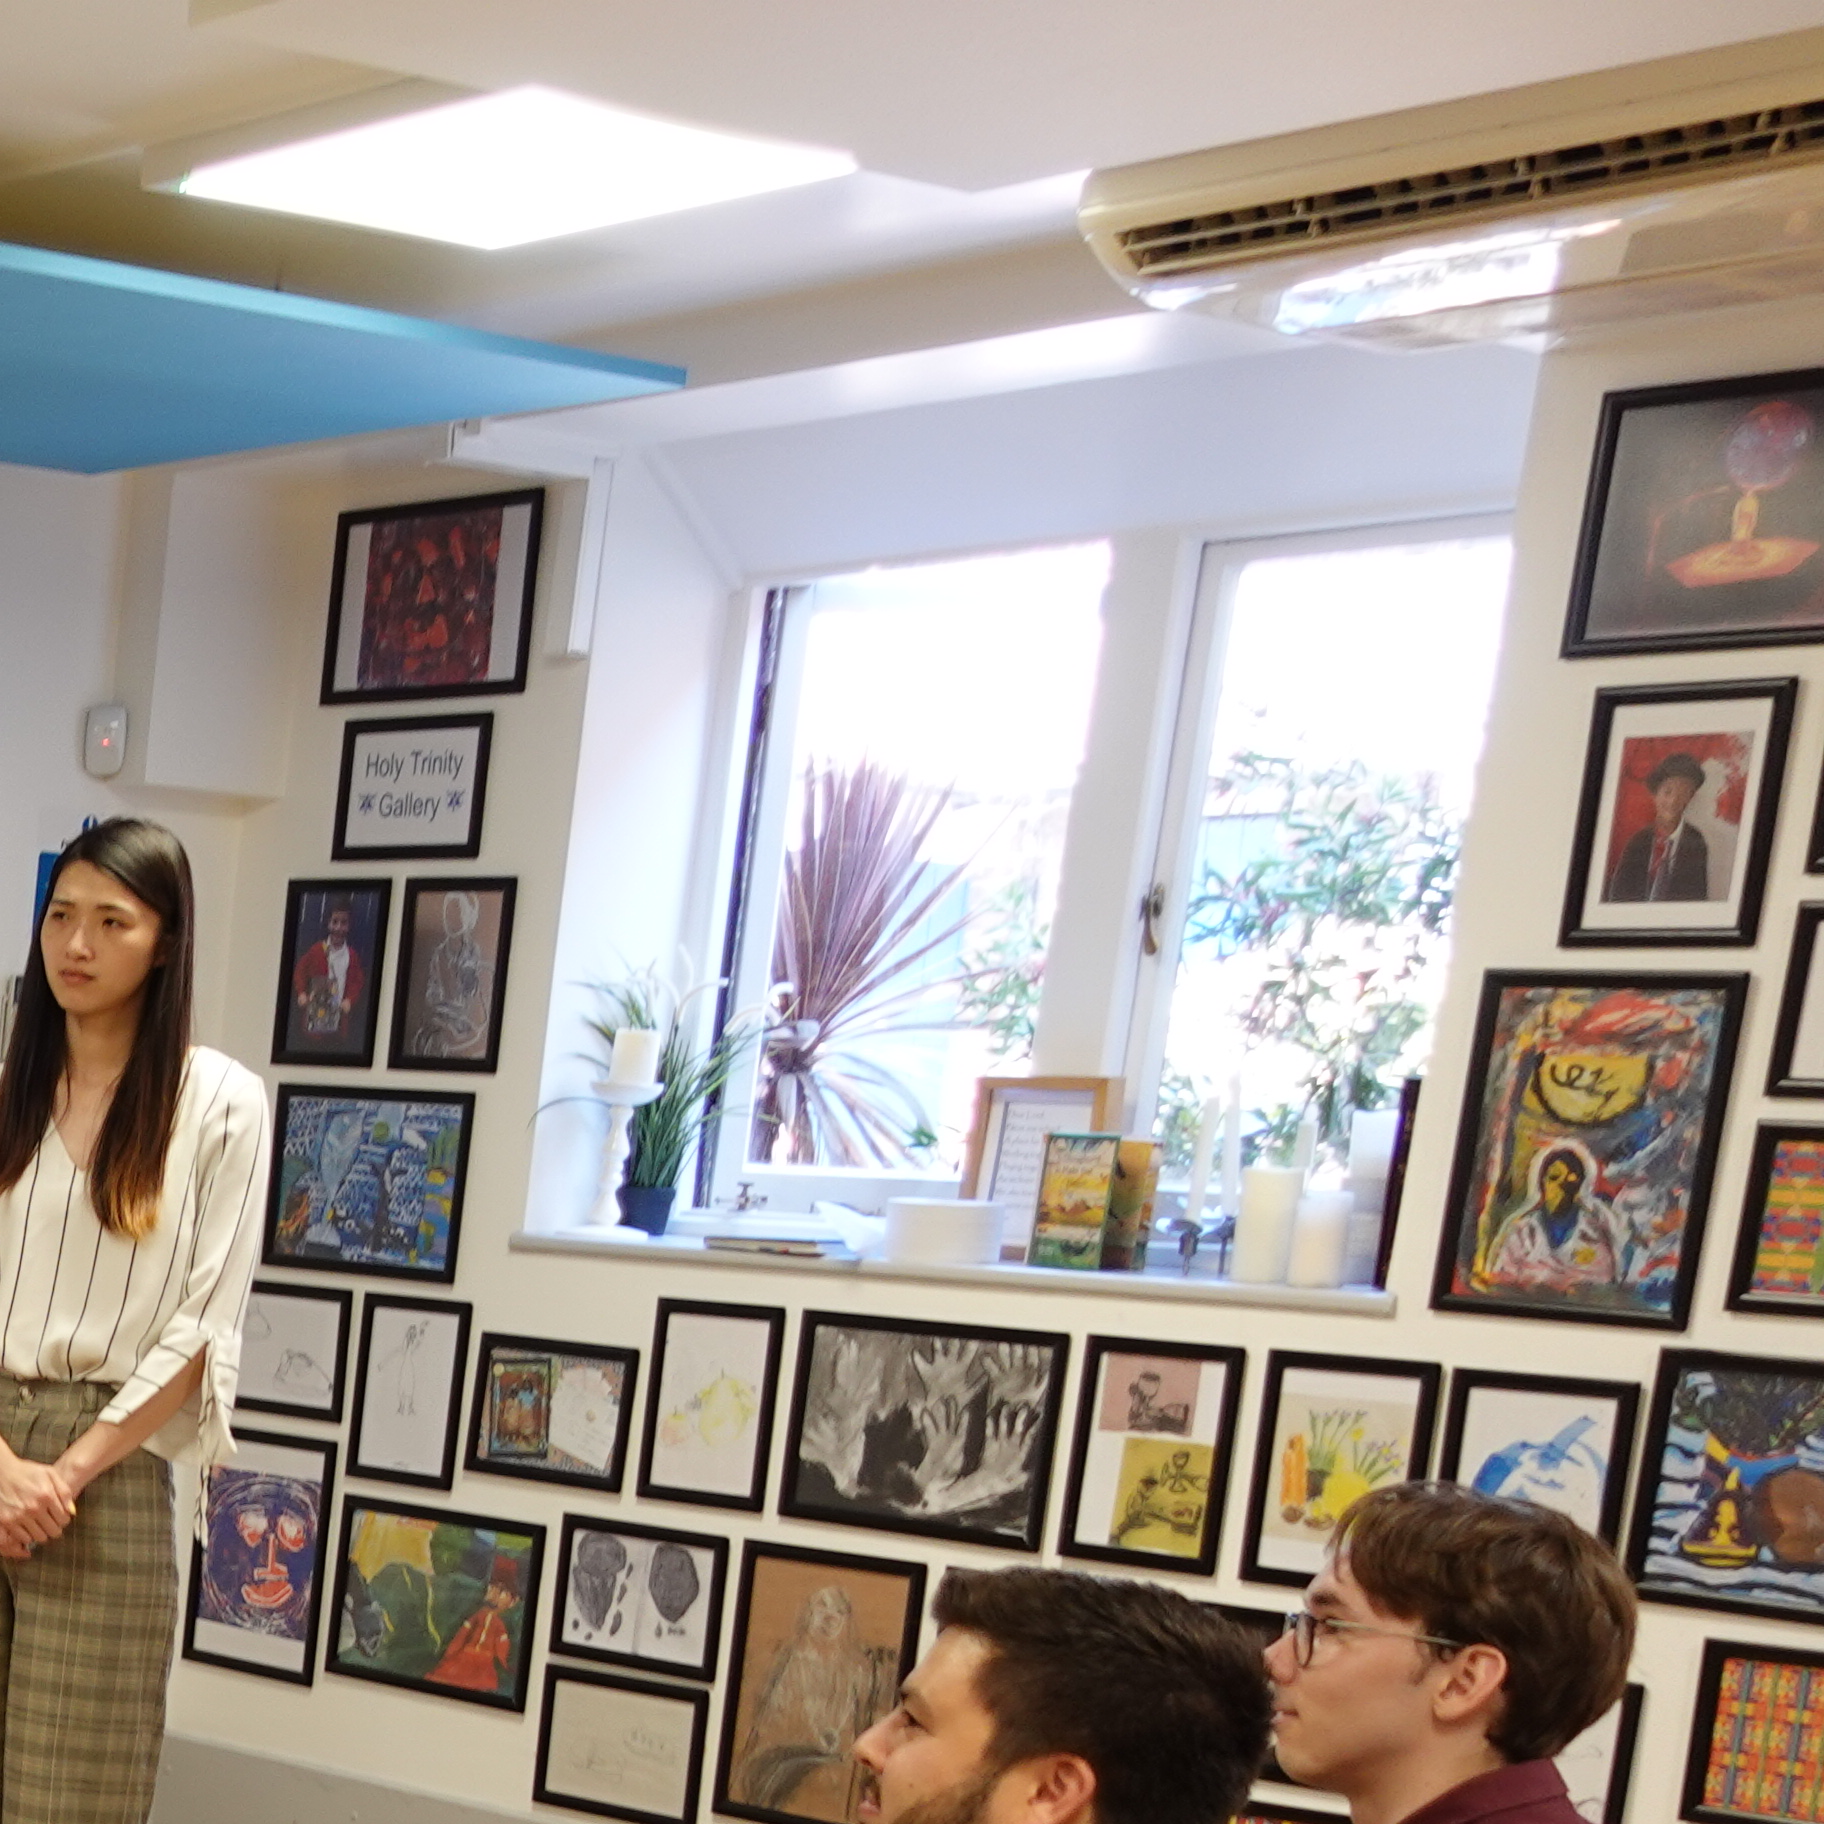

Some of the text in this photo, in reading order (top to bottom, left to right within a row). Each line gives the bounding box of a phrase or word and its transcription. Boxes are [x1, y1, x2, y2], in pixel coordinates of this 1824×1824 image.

[365, 748, 464, 784] Holy Trinity
[378, 791, 442, 822] Gallery
